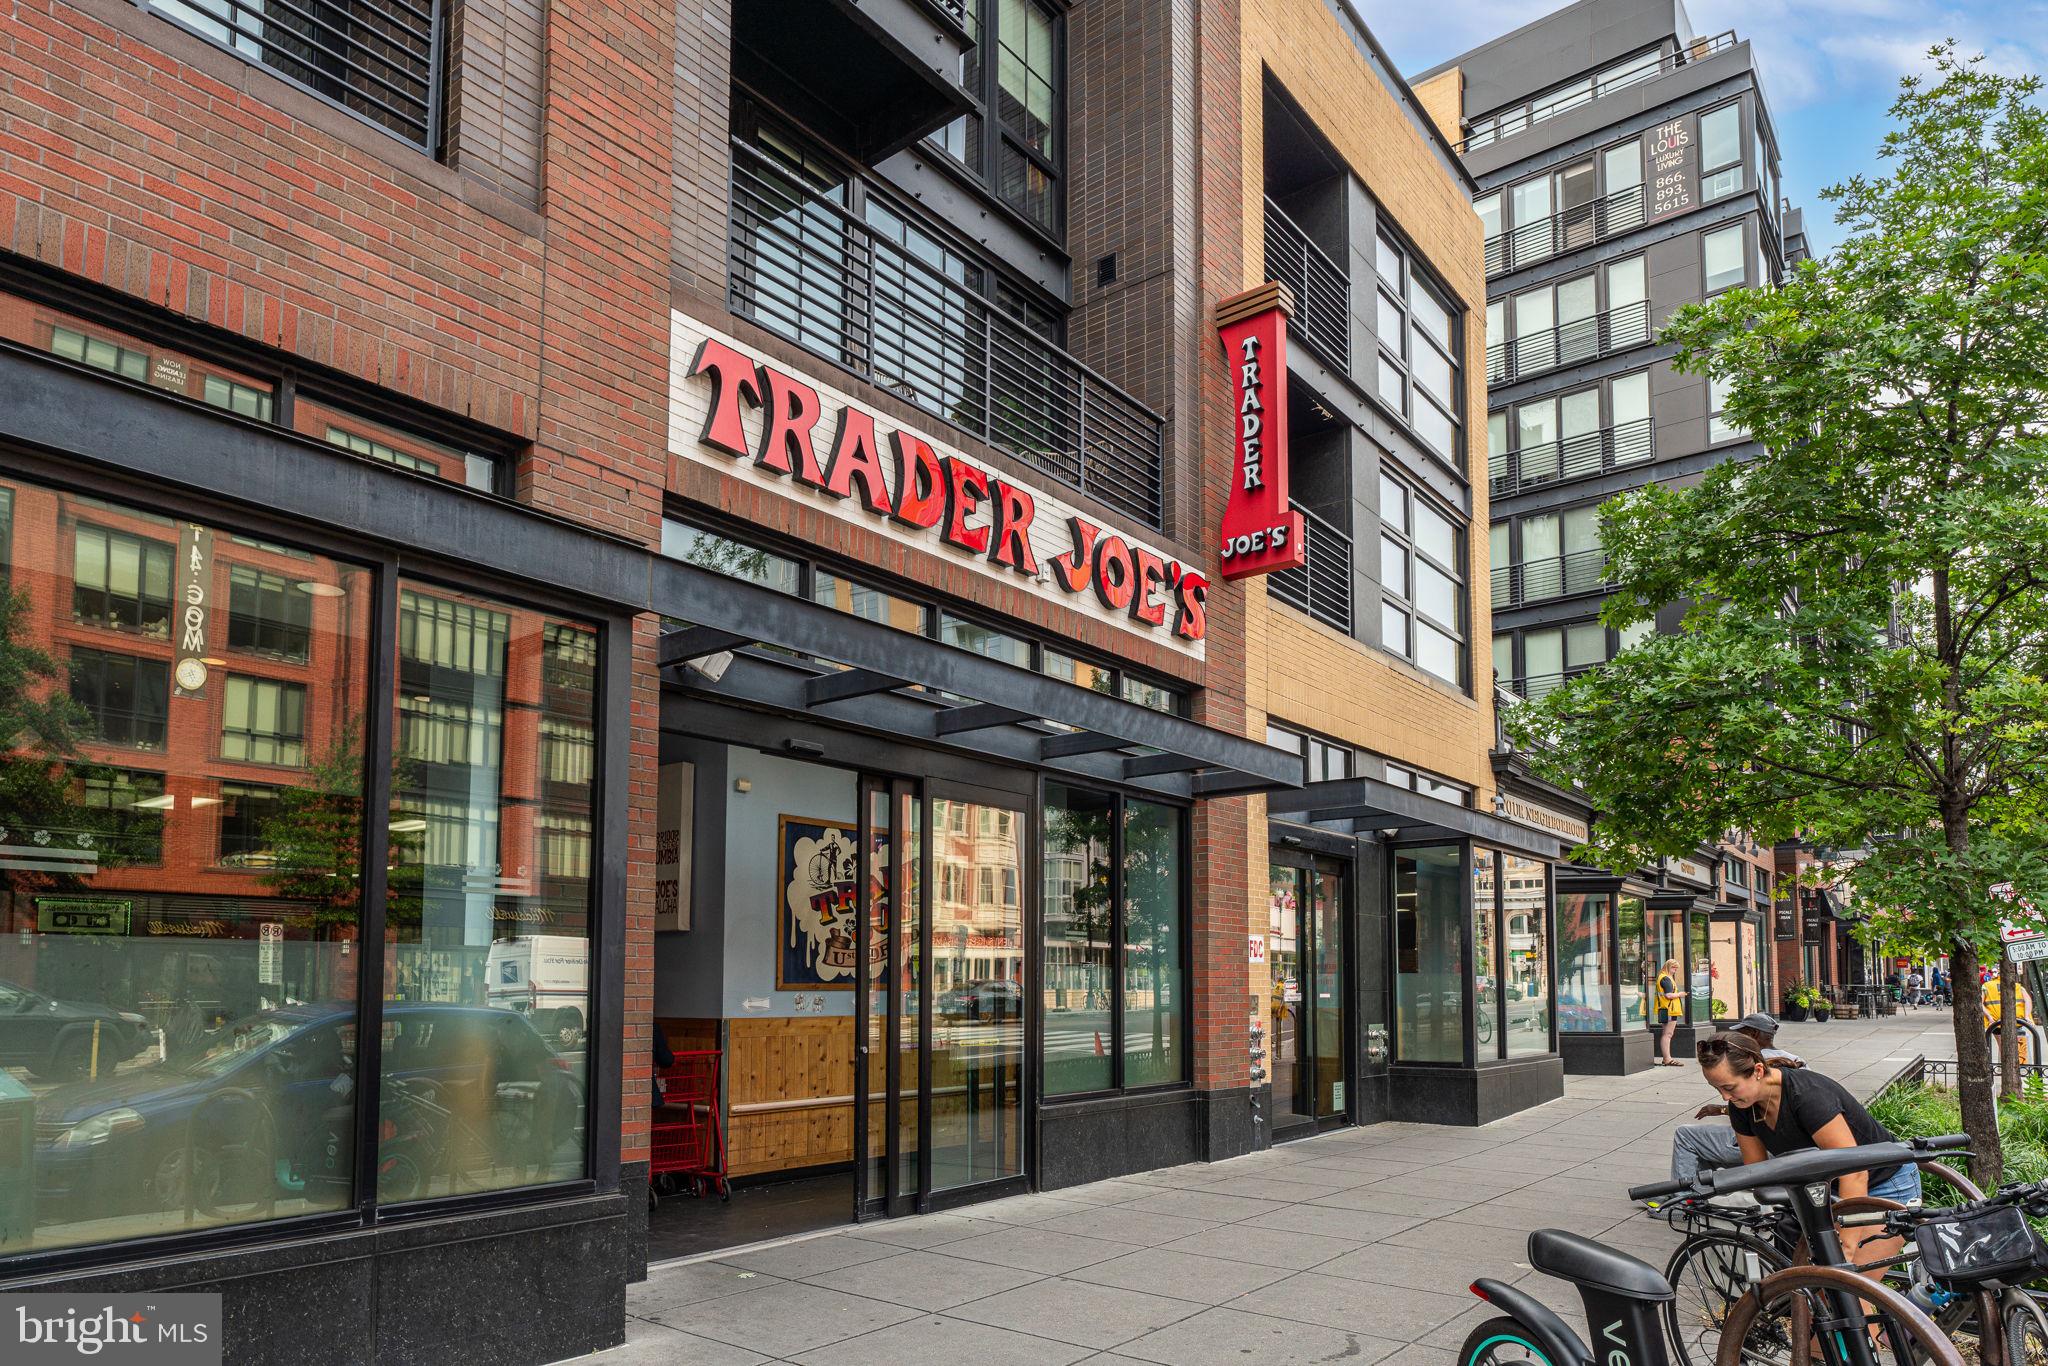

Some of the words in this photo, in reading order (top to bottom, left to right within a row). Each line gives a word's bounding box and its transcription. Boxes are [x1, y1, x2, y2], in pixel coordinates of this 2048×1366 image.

[1656, 120, 1683, 140] THE
[1651, 132, 1689, 156] LOUIS
[1656, 147, 1685, 164] LUXURY
[1657, 156, 1684, 172] LIVING
[1656, 171, 1686, 189] 866.
[1656, 183, 1687, 201] 893.
[1654, 194, 1689, 215] 5615
[1241, 335, 1264, 491] TRADER
[685, 337, 1039, 576] TRADER
[1046, 516, 1211, 641] JOE'S
[1221, 525, 1290, 560] JOE'S
[1525, 806, 1585, 839] NEIGHBORHOOD
[656, 848, 679, 864] UMBIA
[1249, 940, 1264, 958] FDC
[2025, 943, 2036, 951] AM
